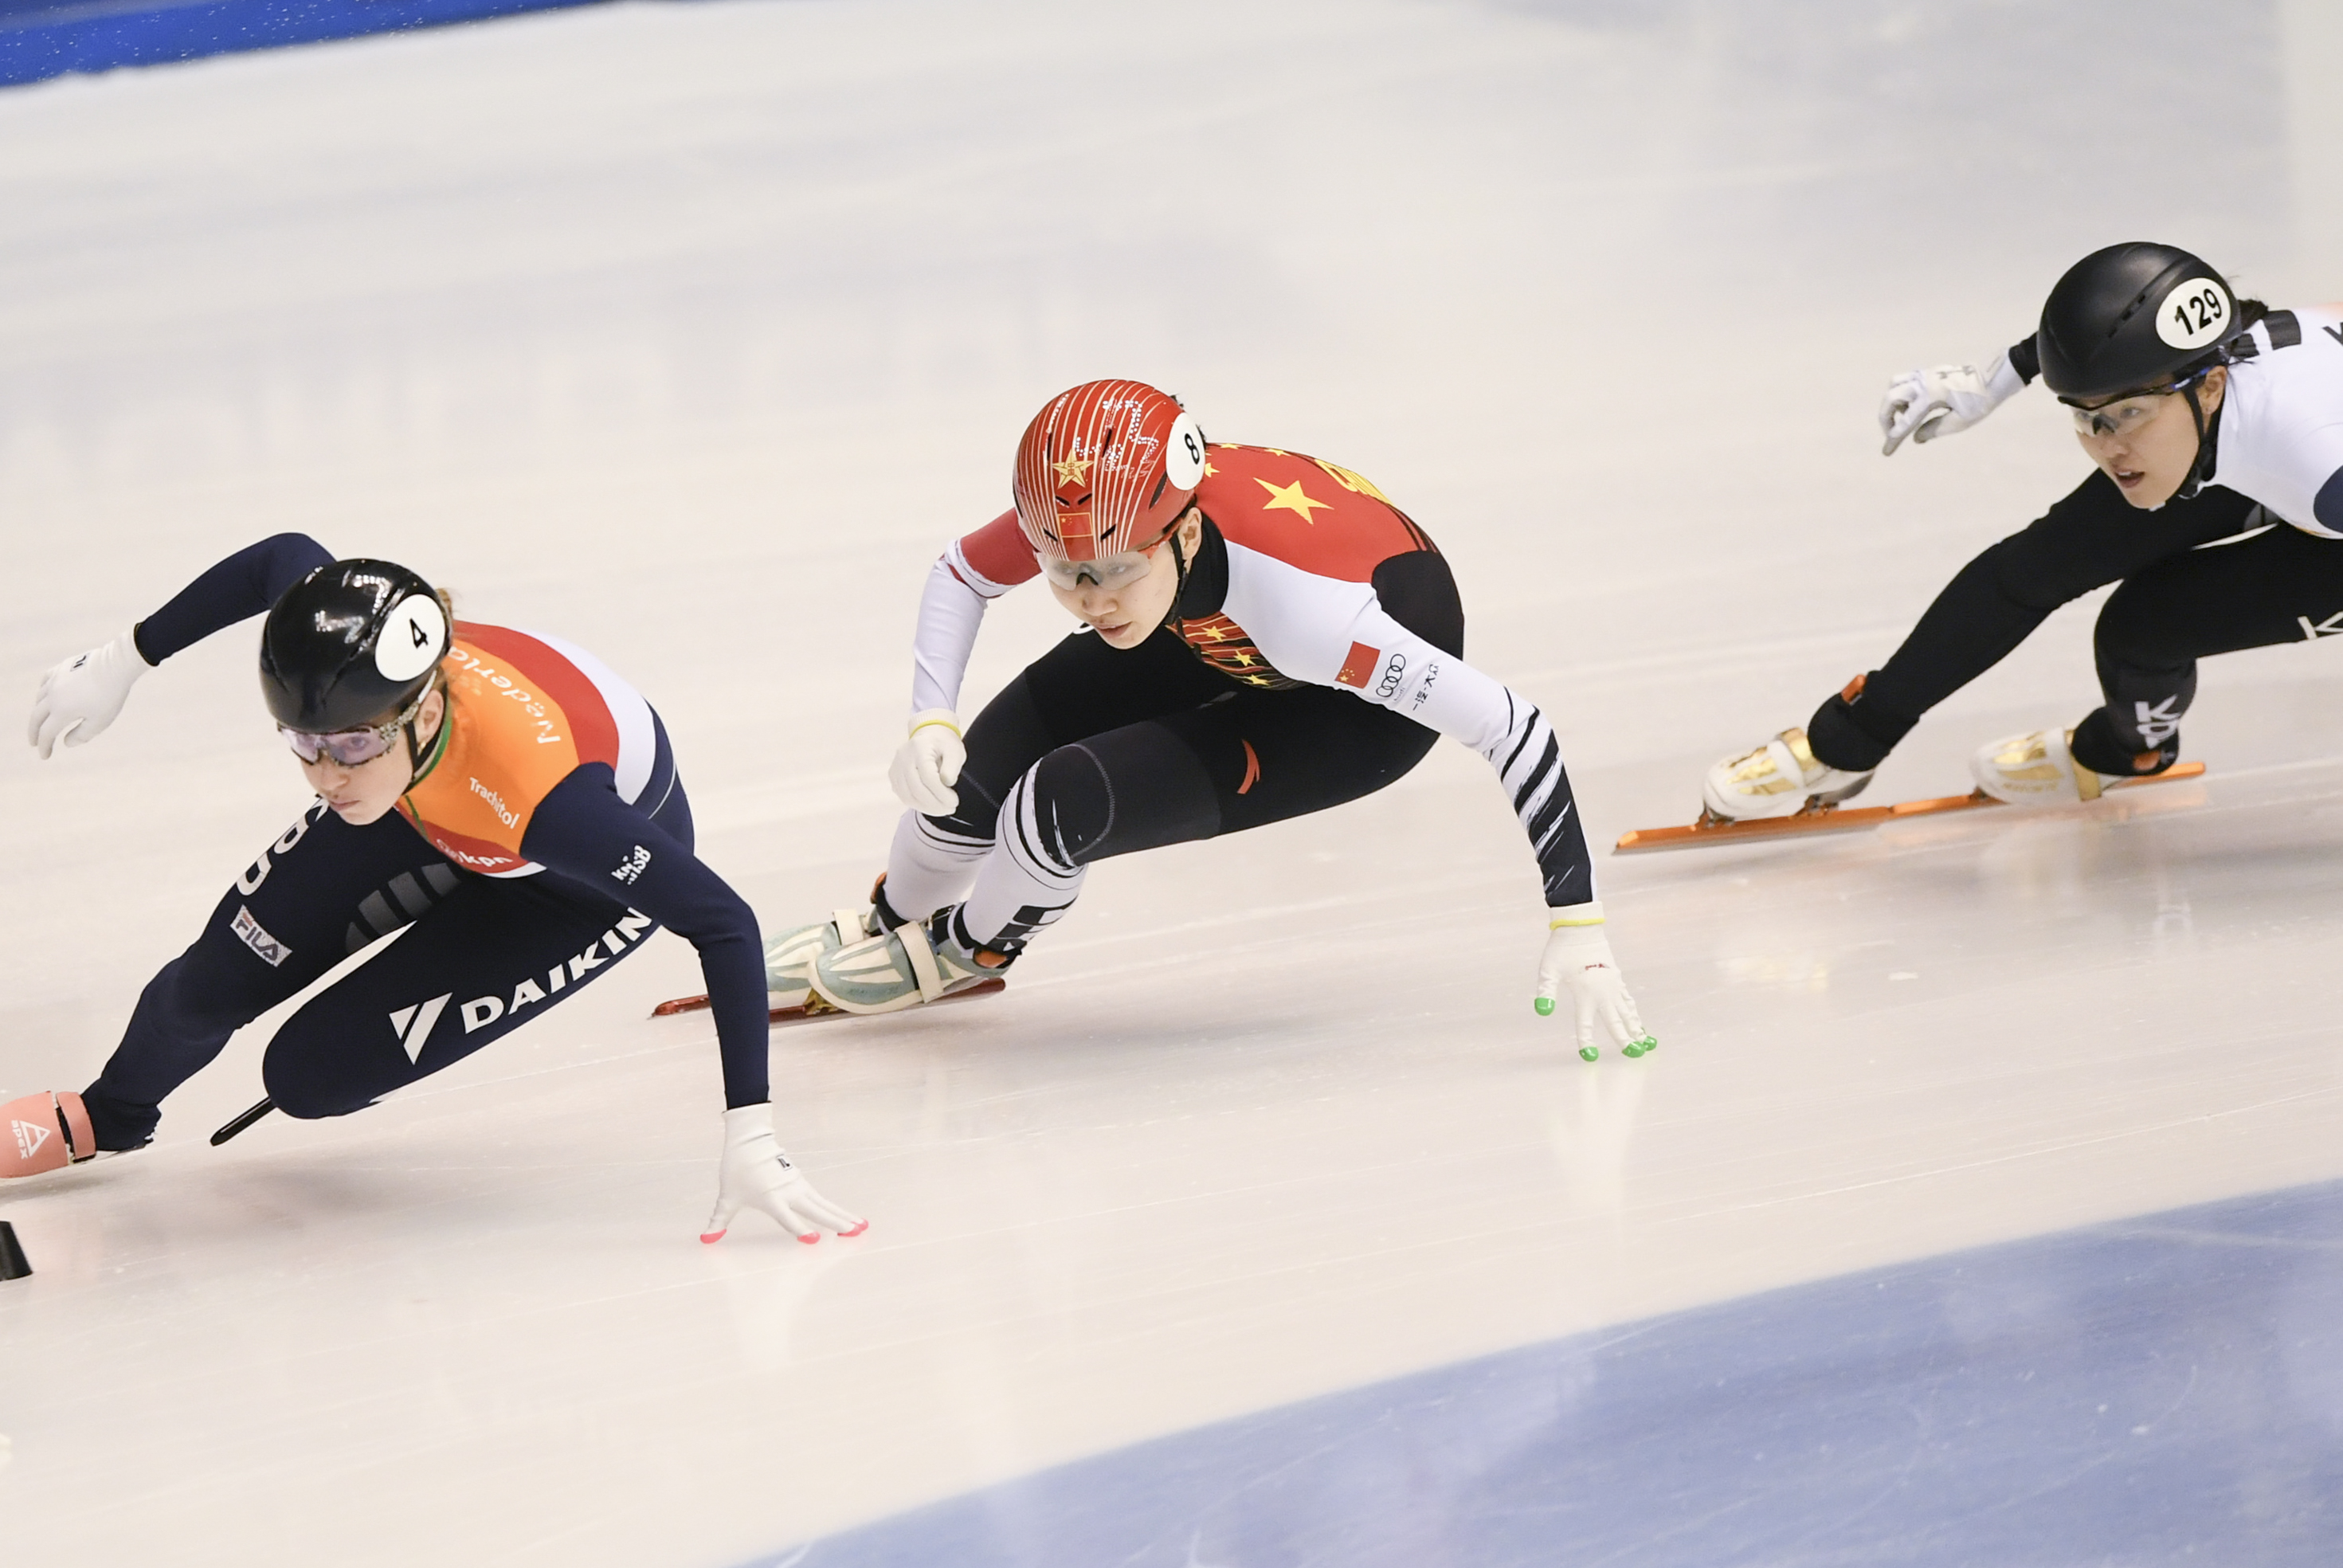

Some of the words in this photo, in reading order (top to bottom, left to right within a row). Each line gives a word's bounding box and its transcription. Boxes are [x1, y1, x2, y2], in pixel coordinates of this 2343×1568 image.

[2174, 288, 2222, 335] 129
[1184, 433, 1200, 465] 8
[409, 617, 429, 649] 4
[469, 777, 520, 829] Trachitol
[458, 850, 513, 867] kpn
[235, 912, 279, 961] FILA
[460, 906, 652, 1034] DAIKIN
